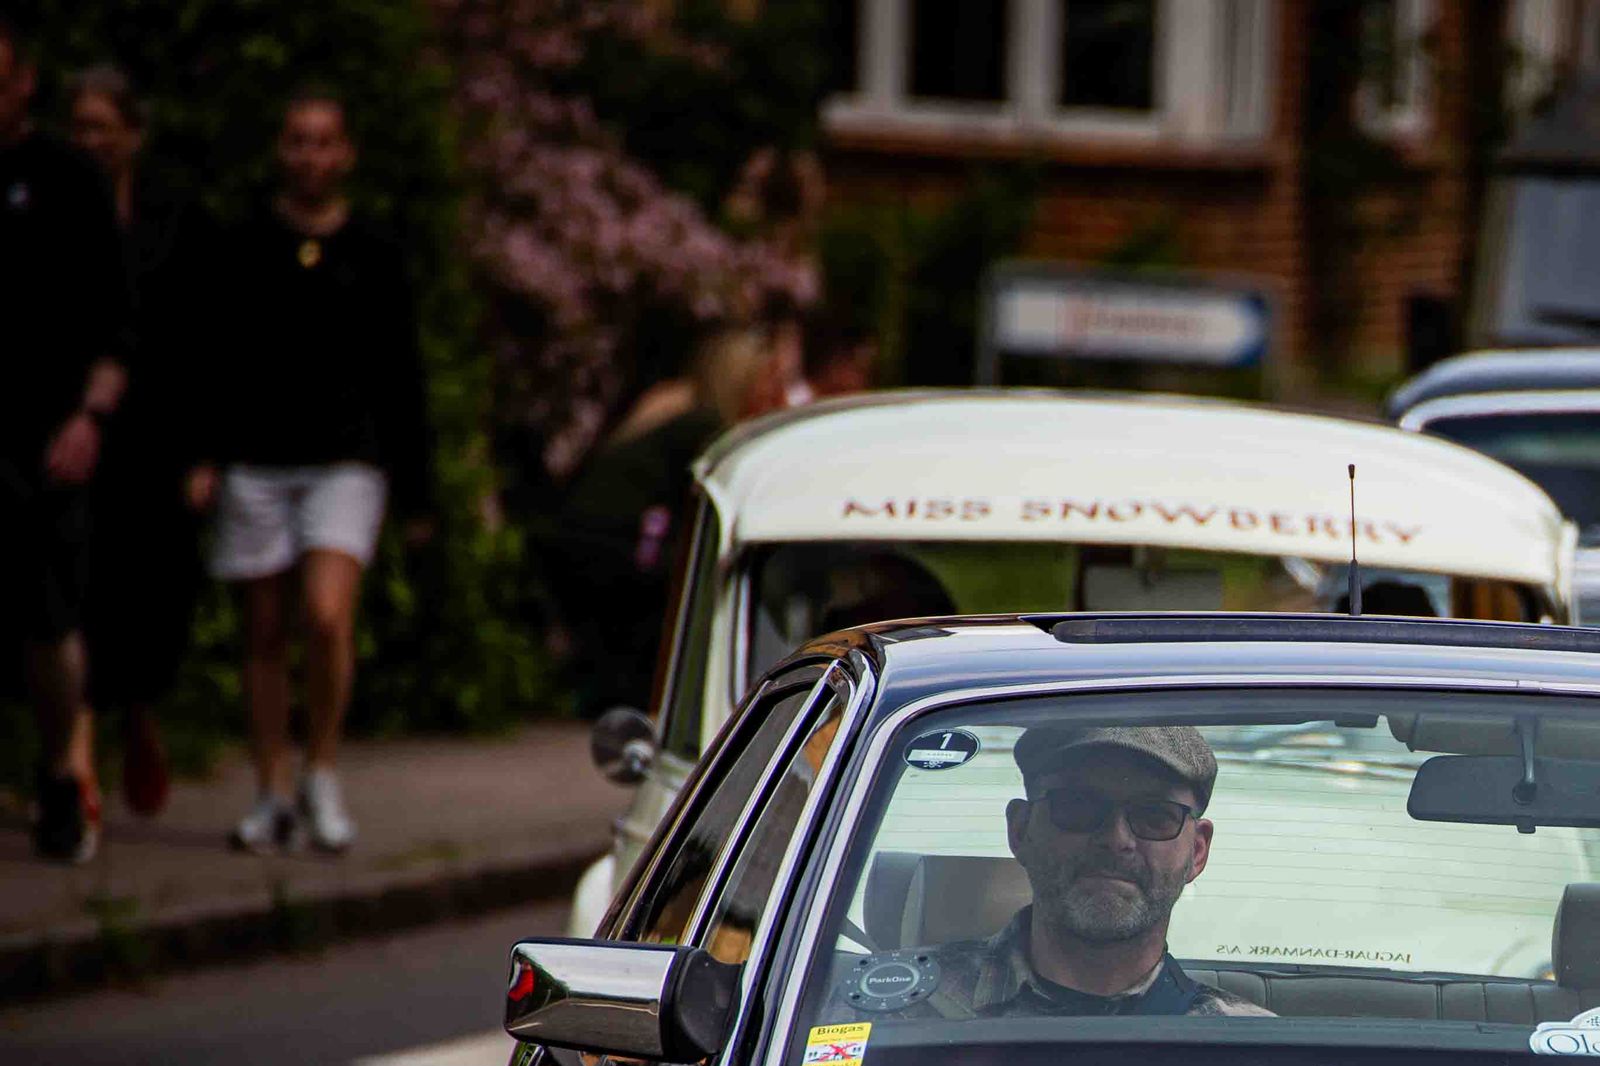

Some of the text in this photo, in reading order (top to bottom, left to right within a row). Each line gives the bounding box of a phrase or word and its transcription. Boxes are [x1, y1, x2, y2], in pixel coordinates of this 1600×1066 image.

[841, 499, 1423, 544] MISS SNOWBERRY
[942, 733, 952, 749] 1
[869, 976, 911, 984] ParkOne
[817, 1025, 864, 1035] Biogas
